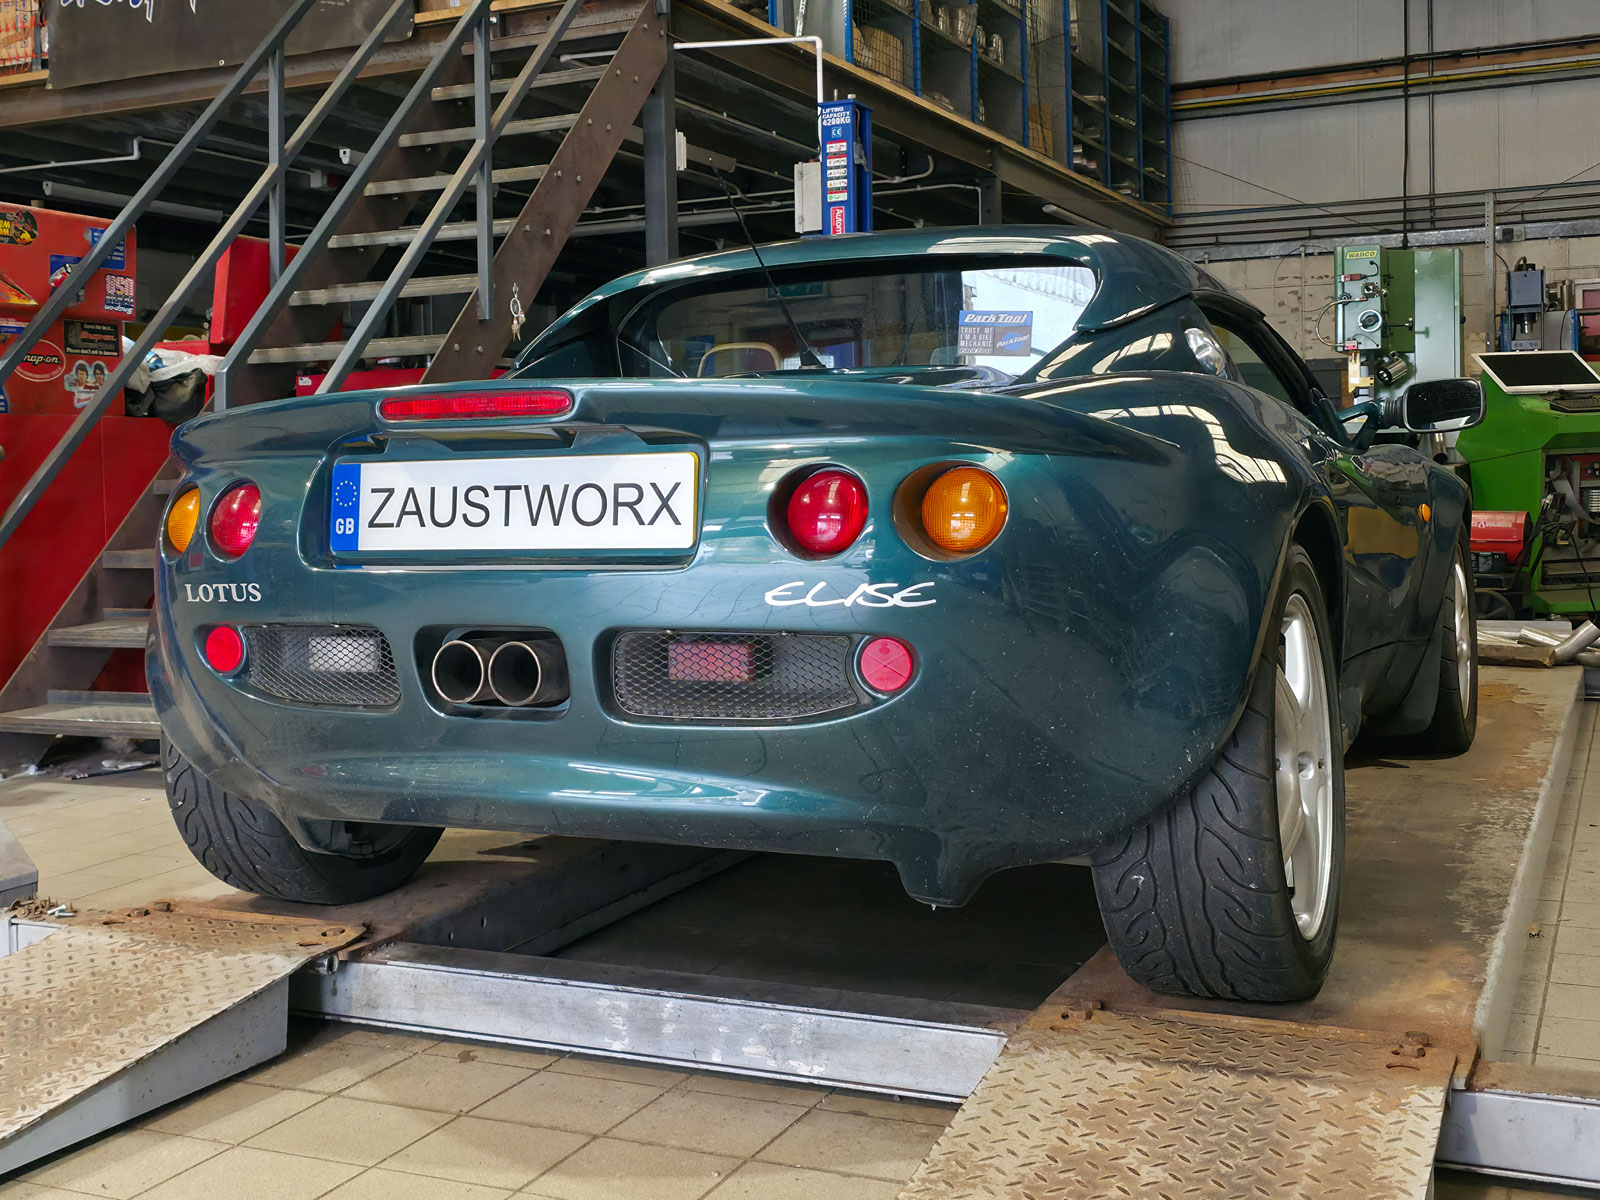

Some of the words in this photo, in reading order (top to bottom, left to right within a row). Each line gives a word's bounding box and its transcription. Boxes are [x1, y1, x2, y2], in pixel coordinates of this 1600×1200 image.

[822, 111, 851, 119] CAPACITY
[822, 116, 851, 126] 4200KG
[964, 313, 997, 322] Park
[998, 313, 1028, 323] Tool
[24, 355, 59, 364] nap-on
[335, 517, 355, 535] GB
[367, 482, 682, 529] ZAUSTWORX
[184, 583, 262, 602] LOTUS
[764, 581, 937, 608] ELISE
